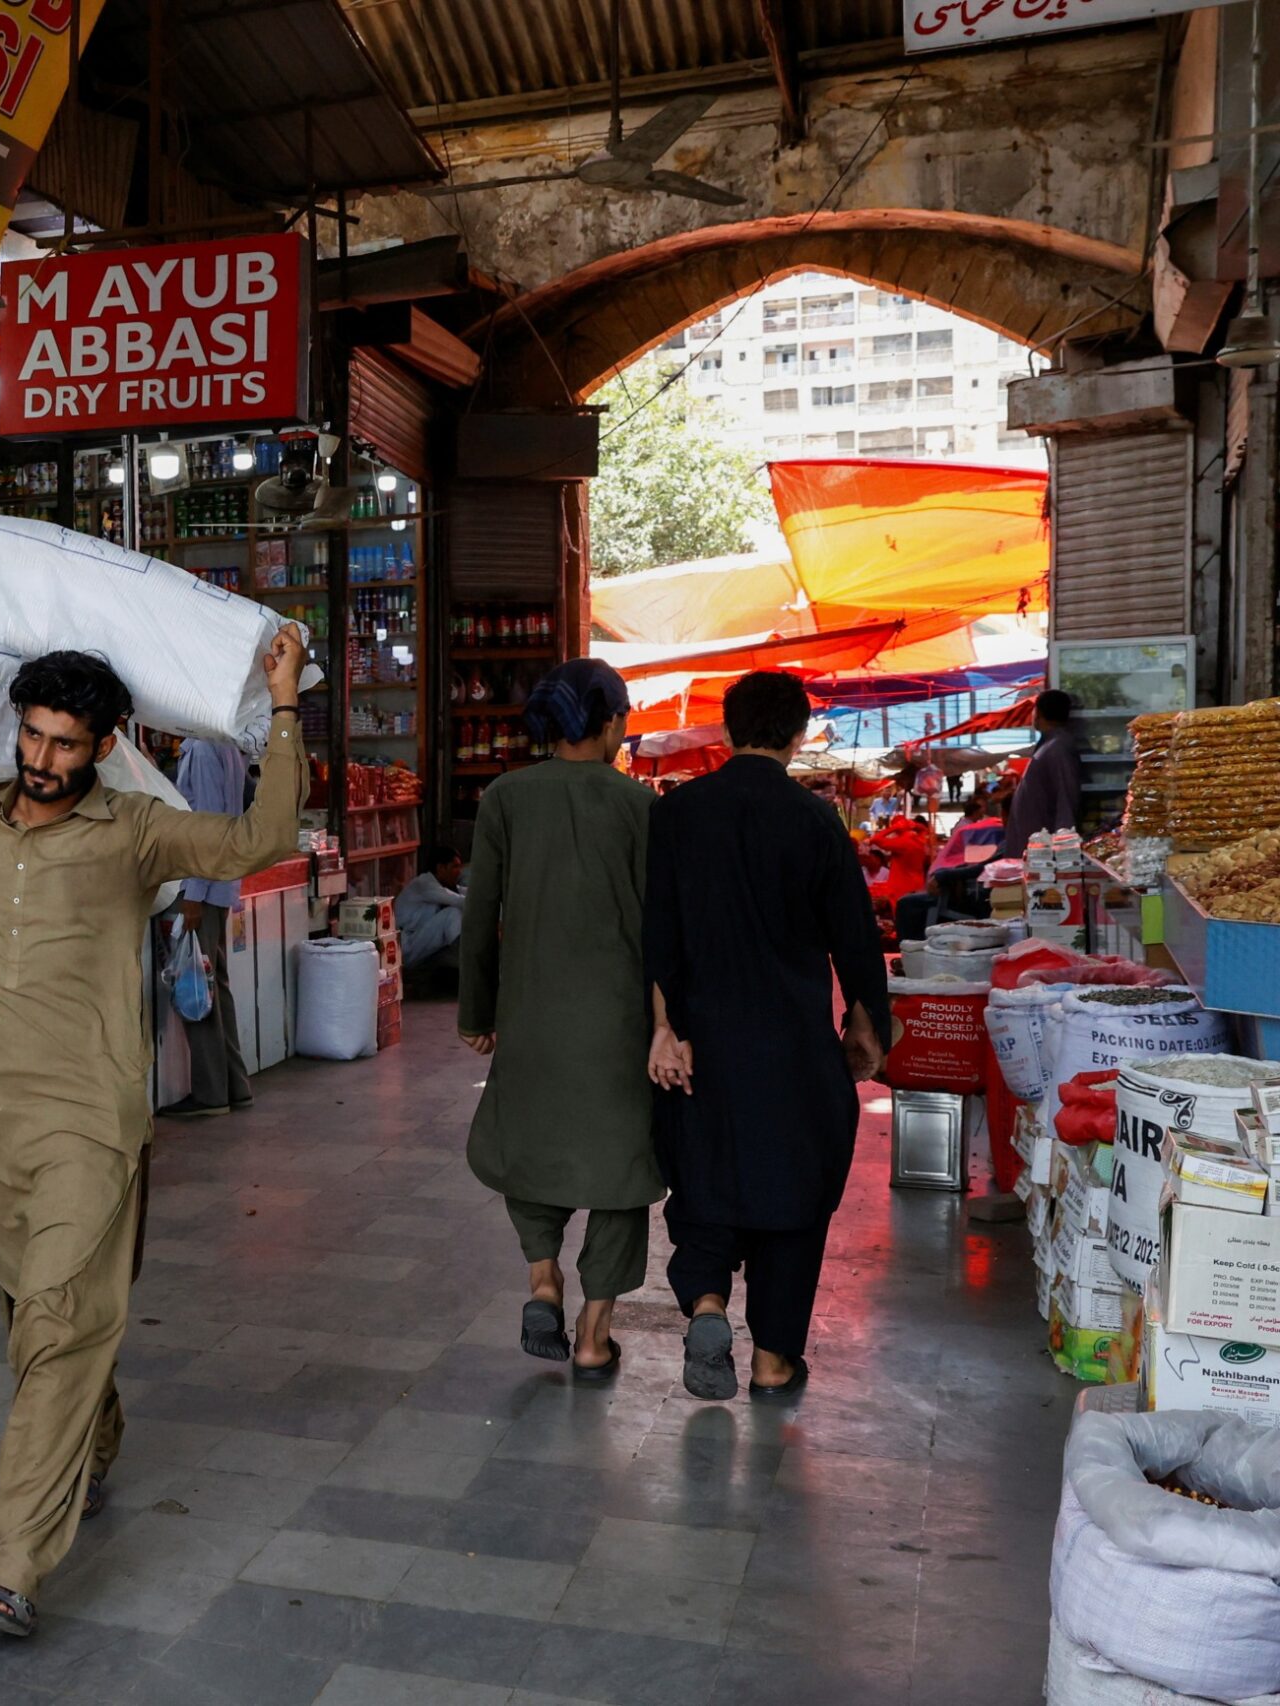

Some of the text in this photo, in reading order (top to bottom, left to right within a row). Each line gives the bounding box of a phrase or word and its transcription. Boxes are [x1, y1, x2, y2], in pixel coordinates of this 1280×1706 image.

[17, 251, 278, 324] M AYUB
[17, 310, 269, 381] ABBASI
[23, 371, 267, 419] DRY FRUITS
[921, 1002, 974, 1013] PROUDLY
[920, 1011, 963, 1022] GROWN
[906, 1018, 986, 1032] PROCESSED IN
[911, 1029, 980, 1041] CALIFORNIA
[1091, 1030, 1155, 1051] PACKING
[1213, 1259, 1235, 1268] Keep
[1236, 1261, 1256, 1270] Cold
[1186, 1317, 1233, 1329] FOR EXPORT
